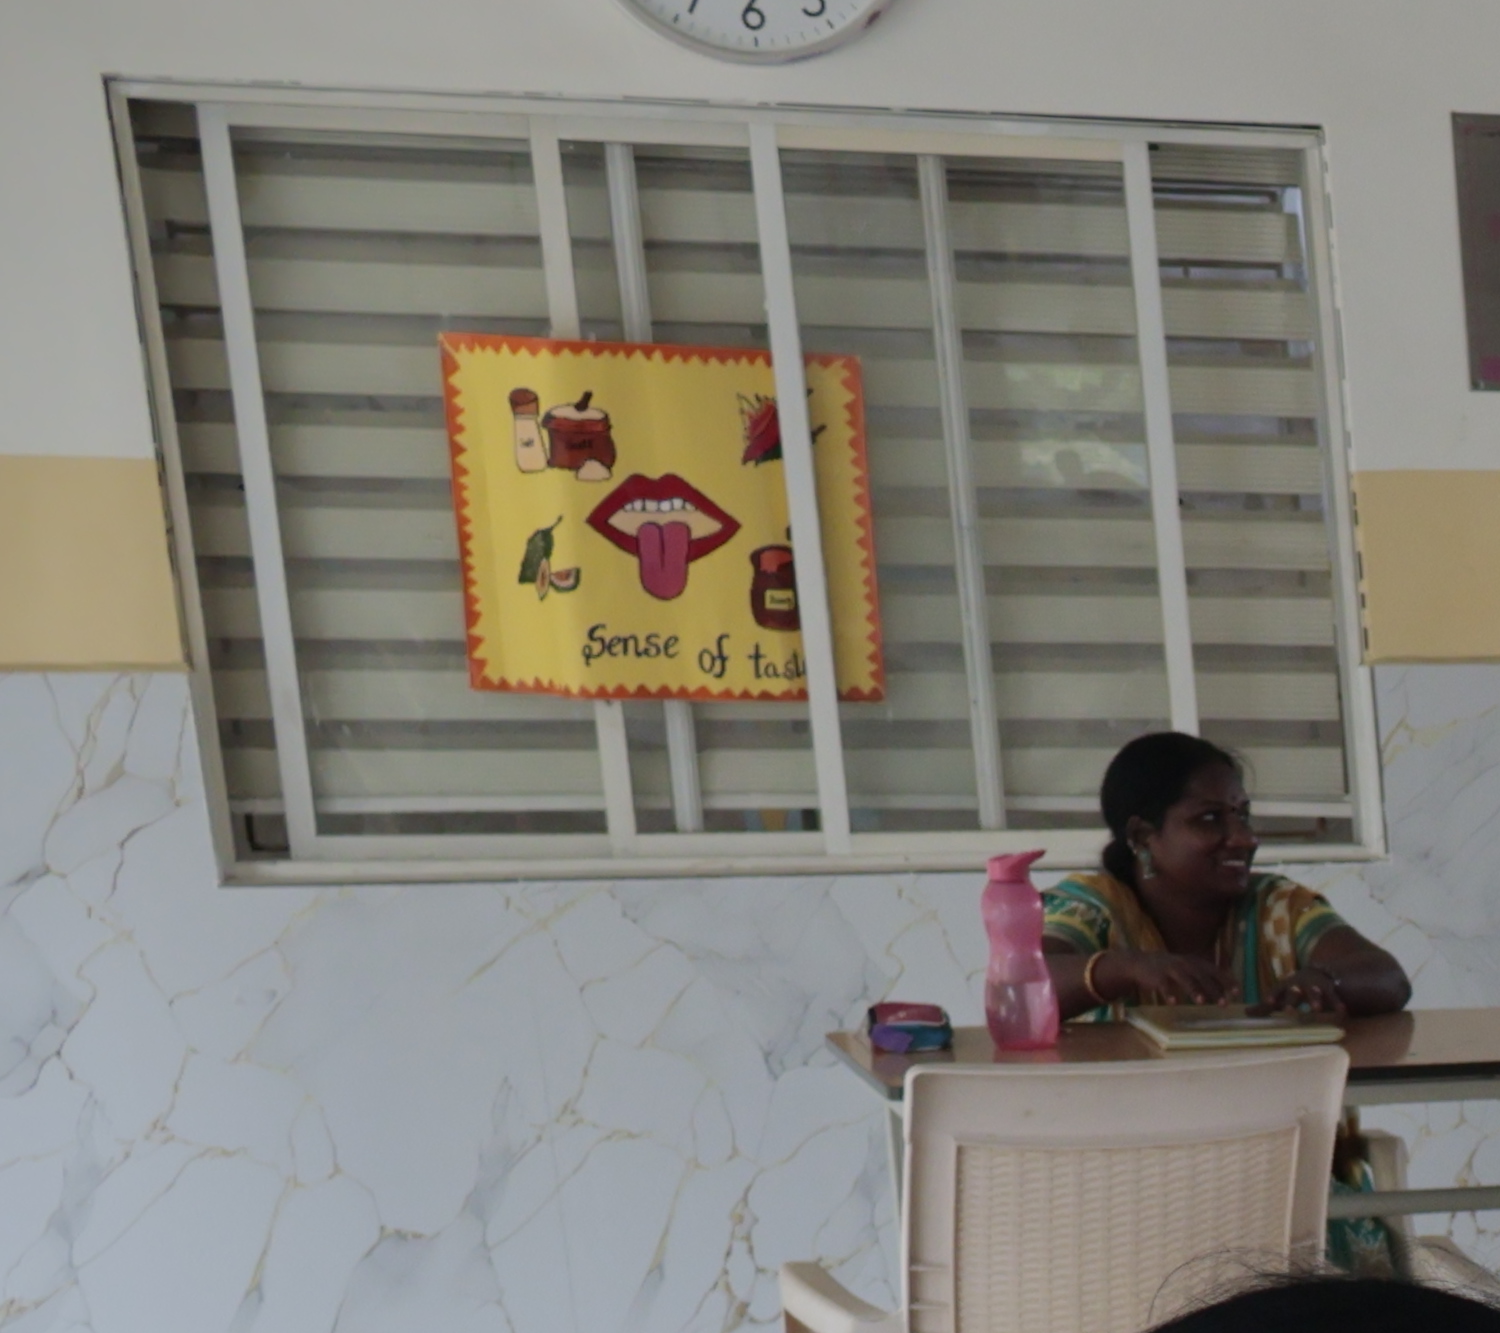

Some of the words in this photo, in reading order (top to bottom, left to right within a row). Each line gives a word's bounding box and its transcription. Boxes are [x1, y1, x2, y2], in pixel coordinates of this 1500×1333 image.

[582, 623, 681, 667] Sense
[699, 632, 731, 680] of
[746, 643, 806, 681] tast
